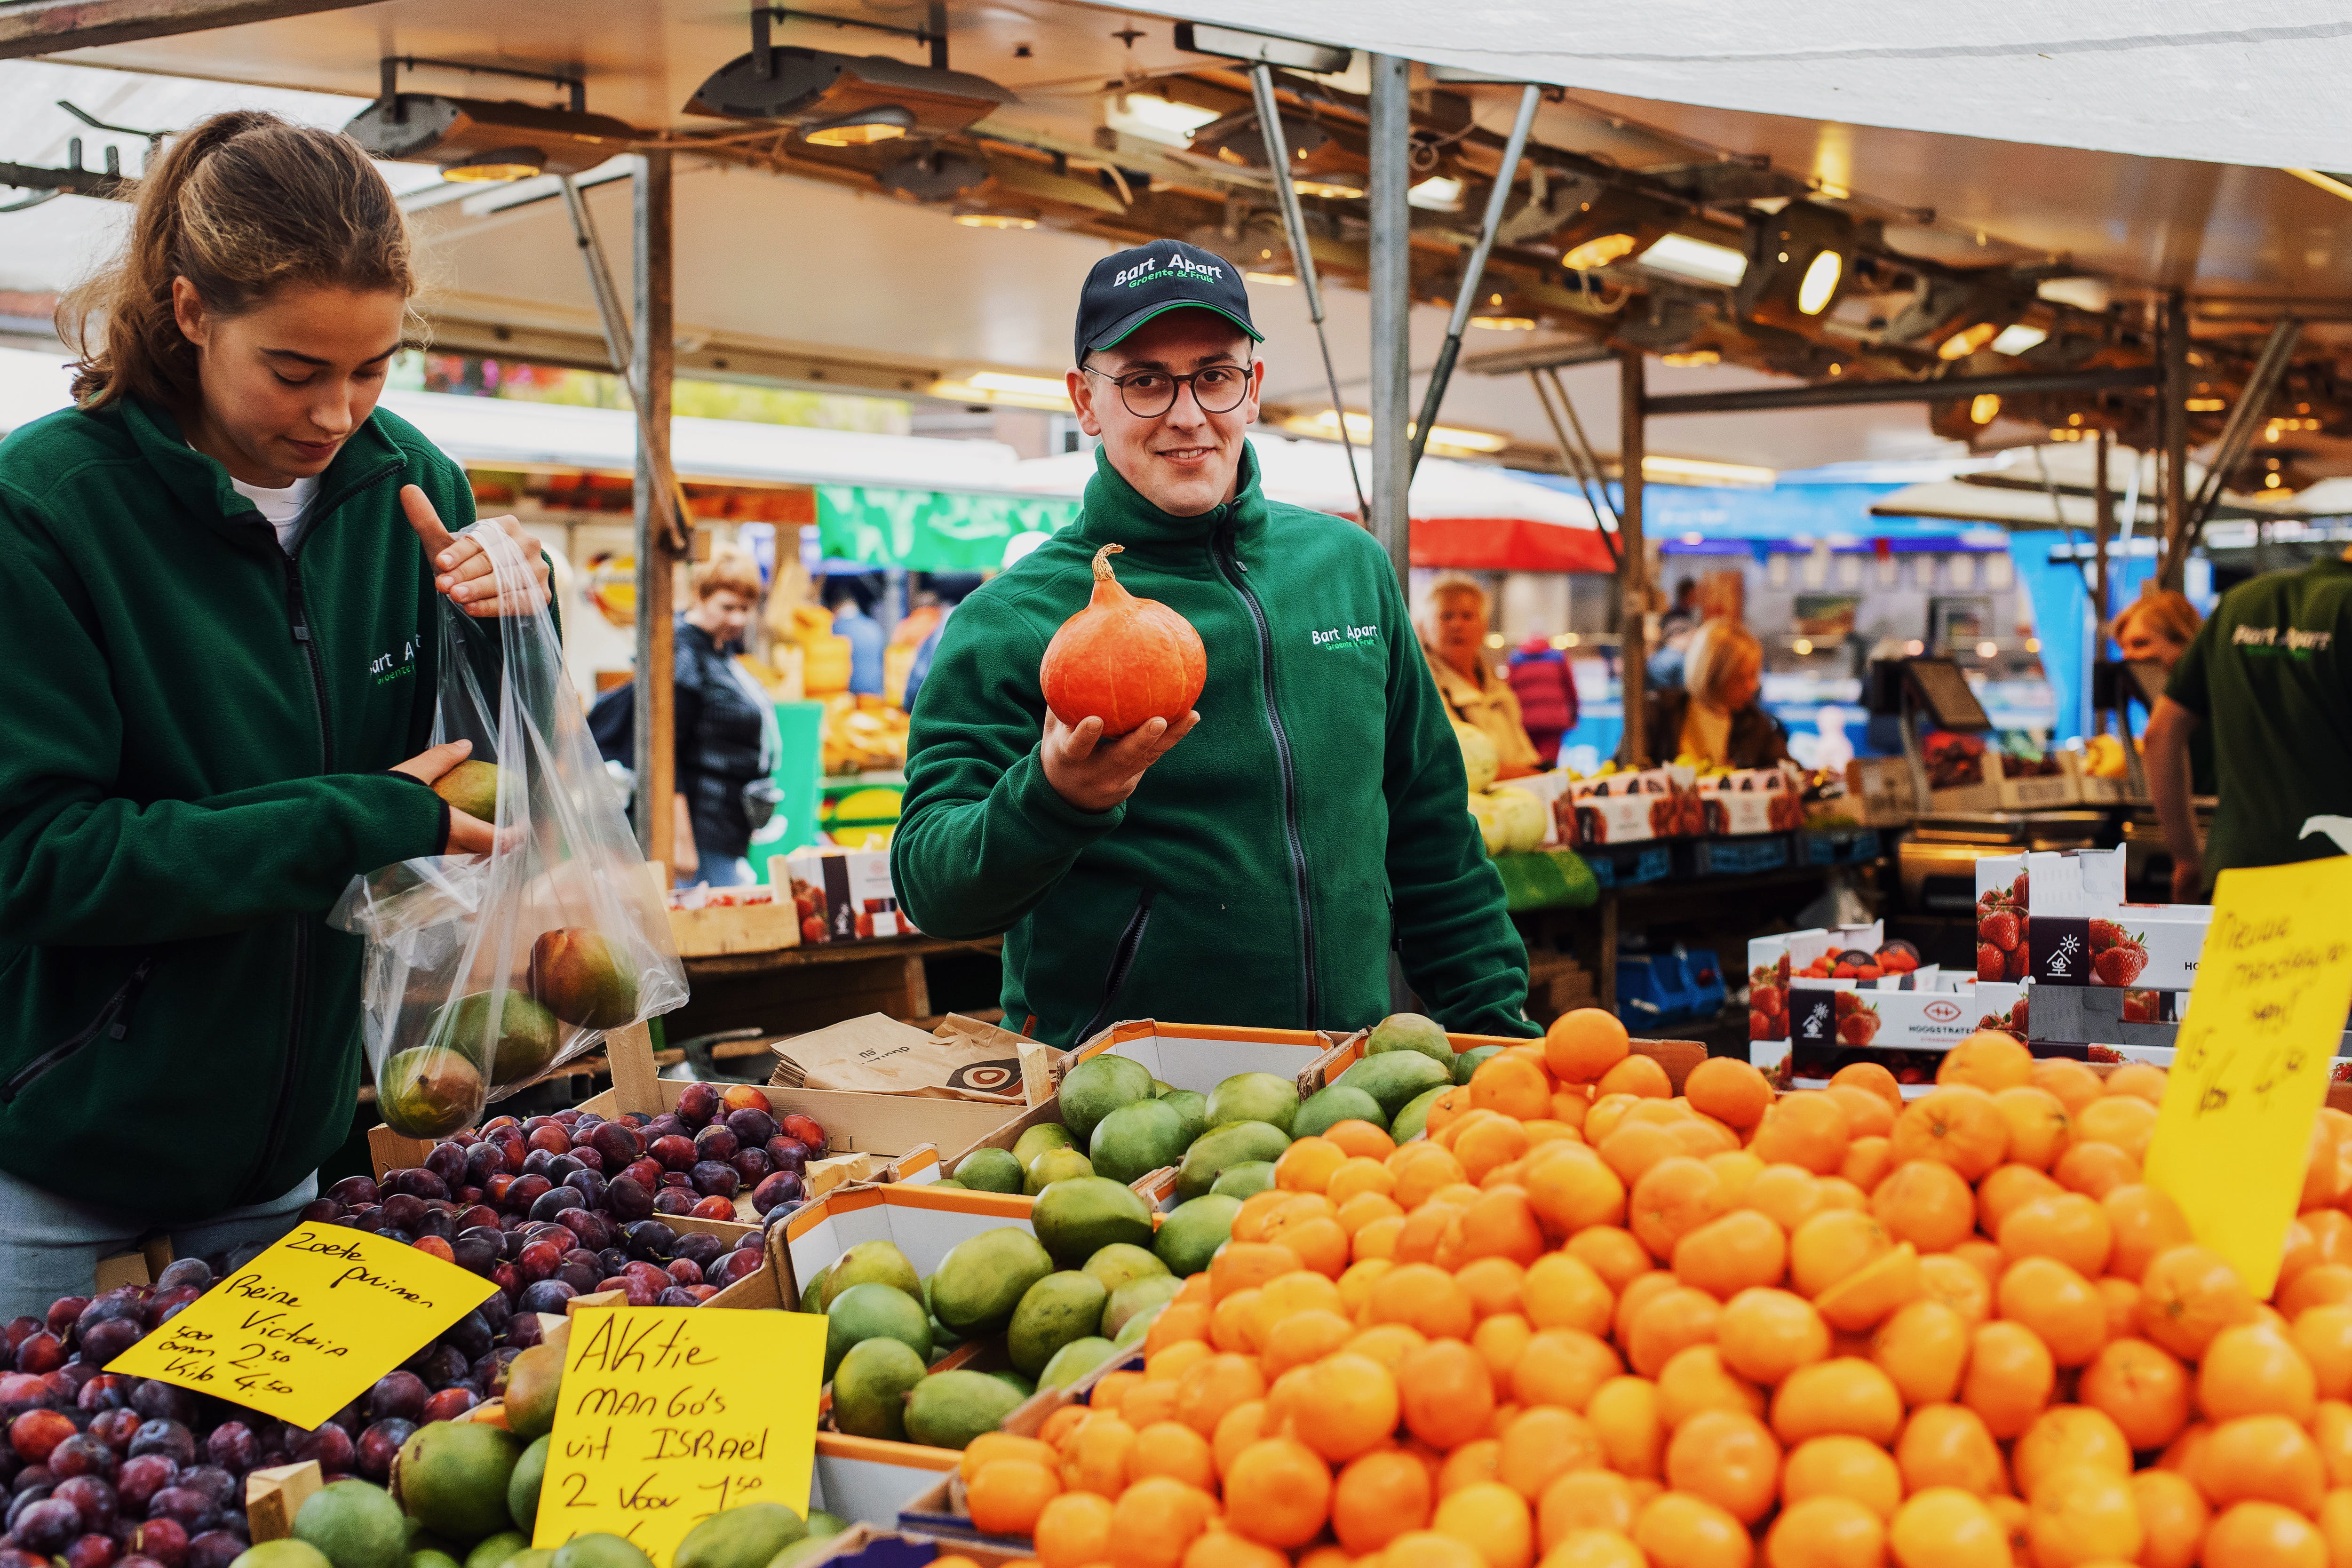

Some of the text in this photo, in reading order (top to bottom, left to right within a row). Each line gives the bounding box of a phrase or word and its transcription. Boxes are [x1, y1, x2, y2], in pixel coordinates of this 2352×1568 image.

[1113, 254, 1223, 287] Bart Apart
[1128, 269, 1174, 288] Groente
[1190, 271, 1215, 284] Fruit
[1311, 624, 1378, 645] Bart Apart
[1326, 641, 1353, 651] Groente
[285, 1233, 366, 1261] Zoete
[225, 1274, 302, 1307] Reine
[170, 1326, 213, 1341] 500
[164, 1357, 215, 1381] Kilo
[562, 1472, 597, 1507] 2
